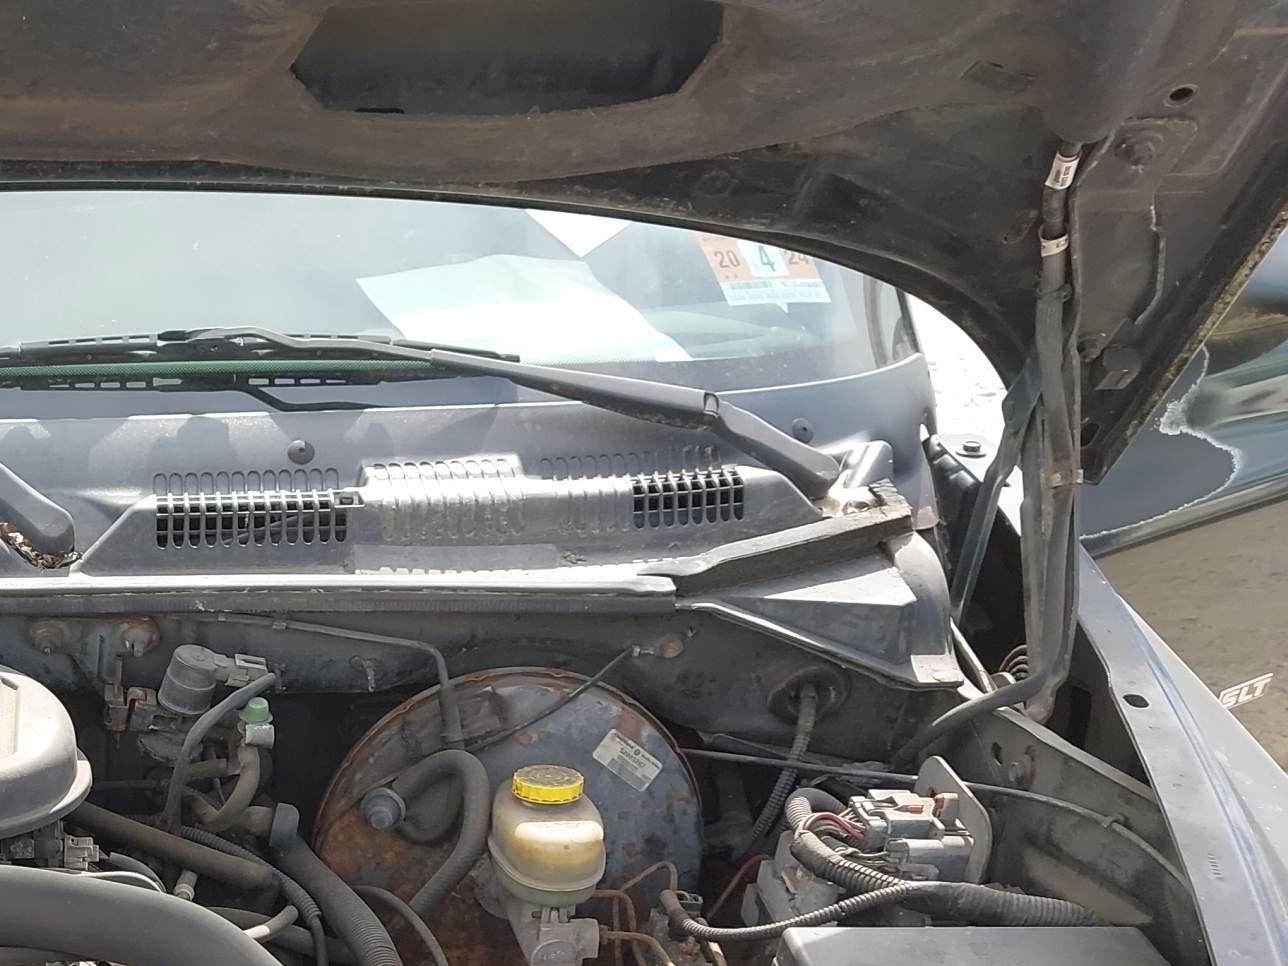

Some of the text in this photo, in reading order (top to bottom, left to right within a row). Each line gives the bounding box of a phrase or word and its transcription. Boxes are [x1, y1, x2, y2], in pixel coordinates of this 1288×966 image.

[714, 250, 740, 268] 20
[759, 246, 776, 272] 4
[1222, 678, 1272, 707] SLT
